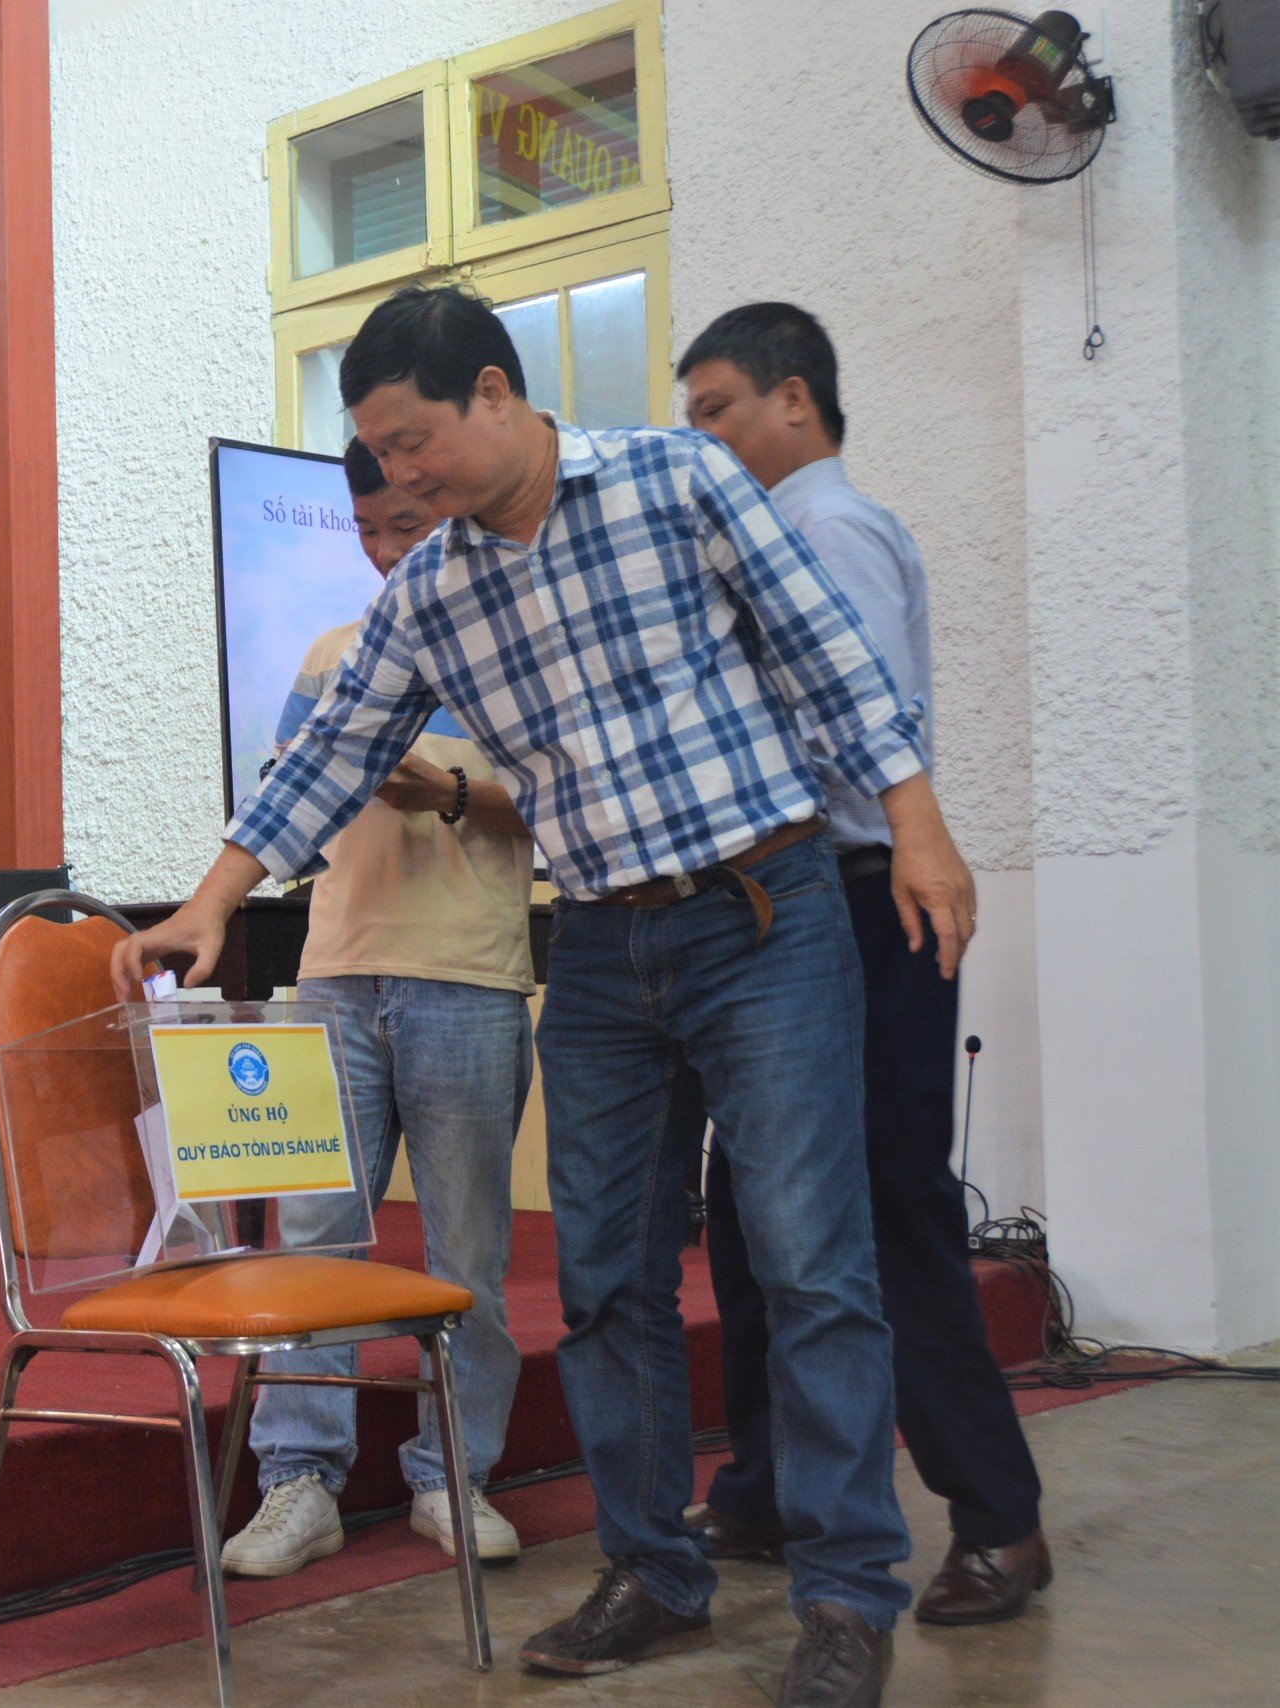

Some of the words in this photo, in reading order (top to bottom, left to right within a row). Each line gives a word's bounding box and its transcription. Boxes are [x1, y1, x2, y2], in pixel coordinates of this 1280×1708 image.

[263, 495, 286, 524] Số
[292, 504, 314, 528] tài
[228, 1103, 261, 1122] ỦNG
[266, 1103, 289, 1125] HỘ
[272, 1142, 285, 1155] DI
